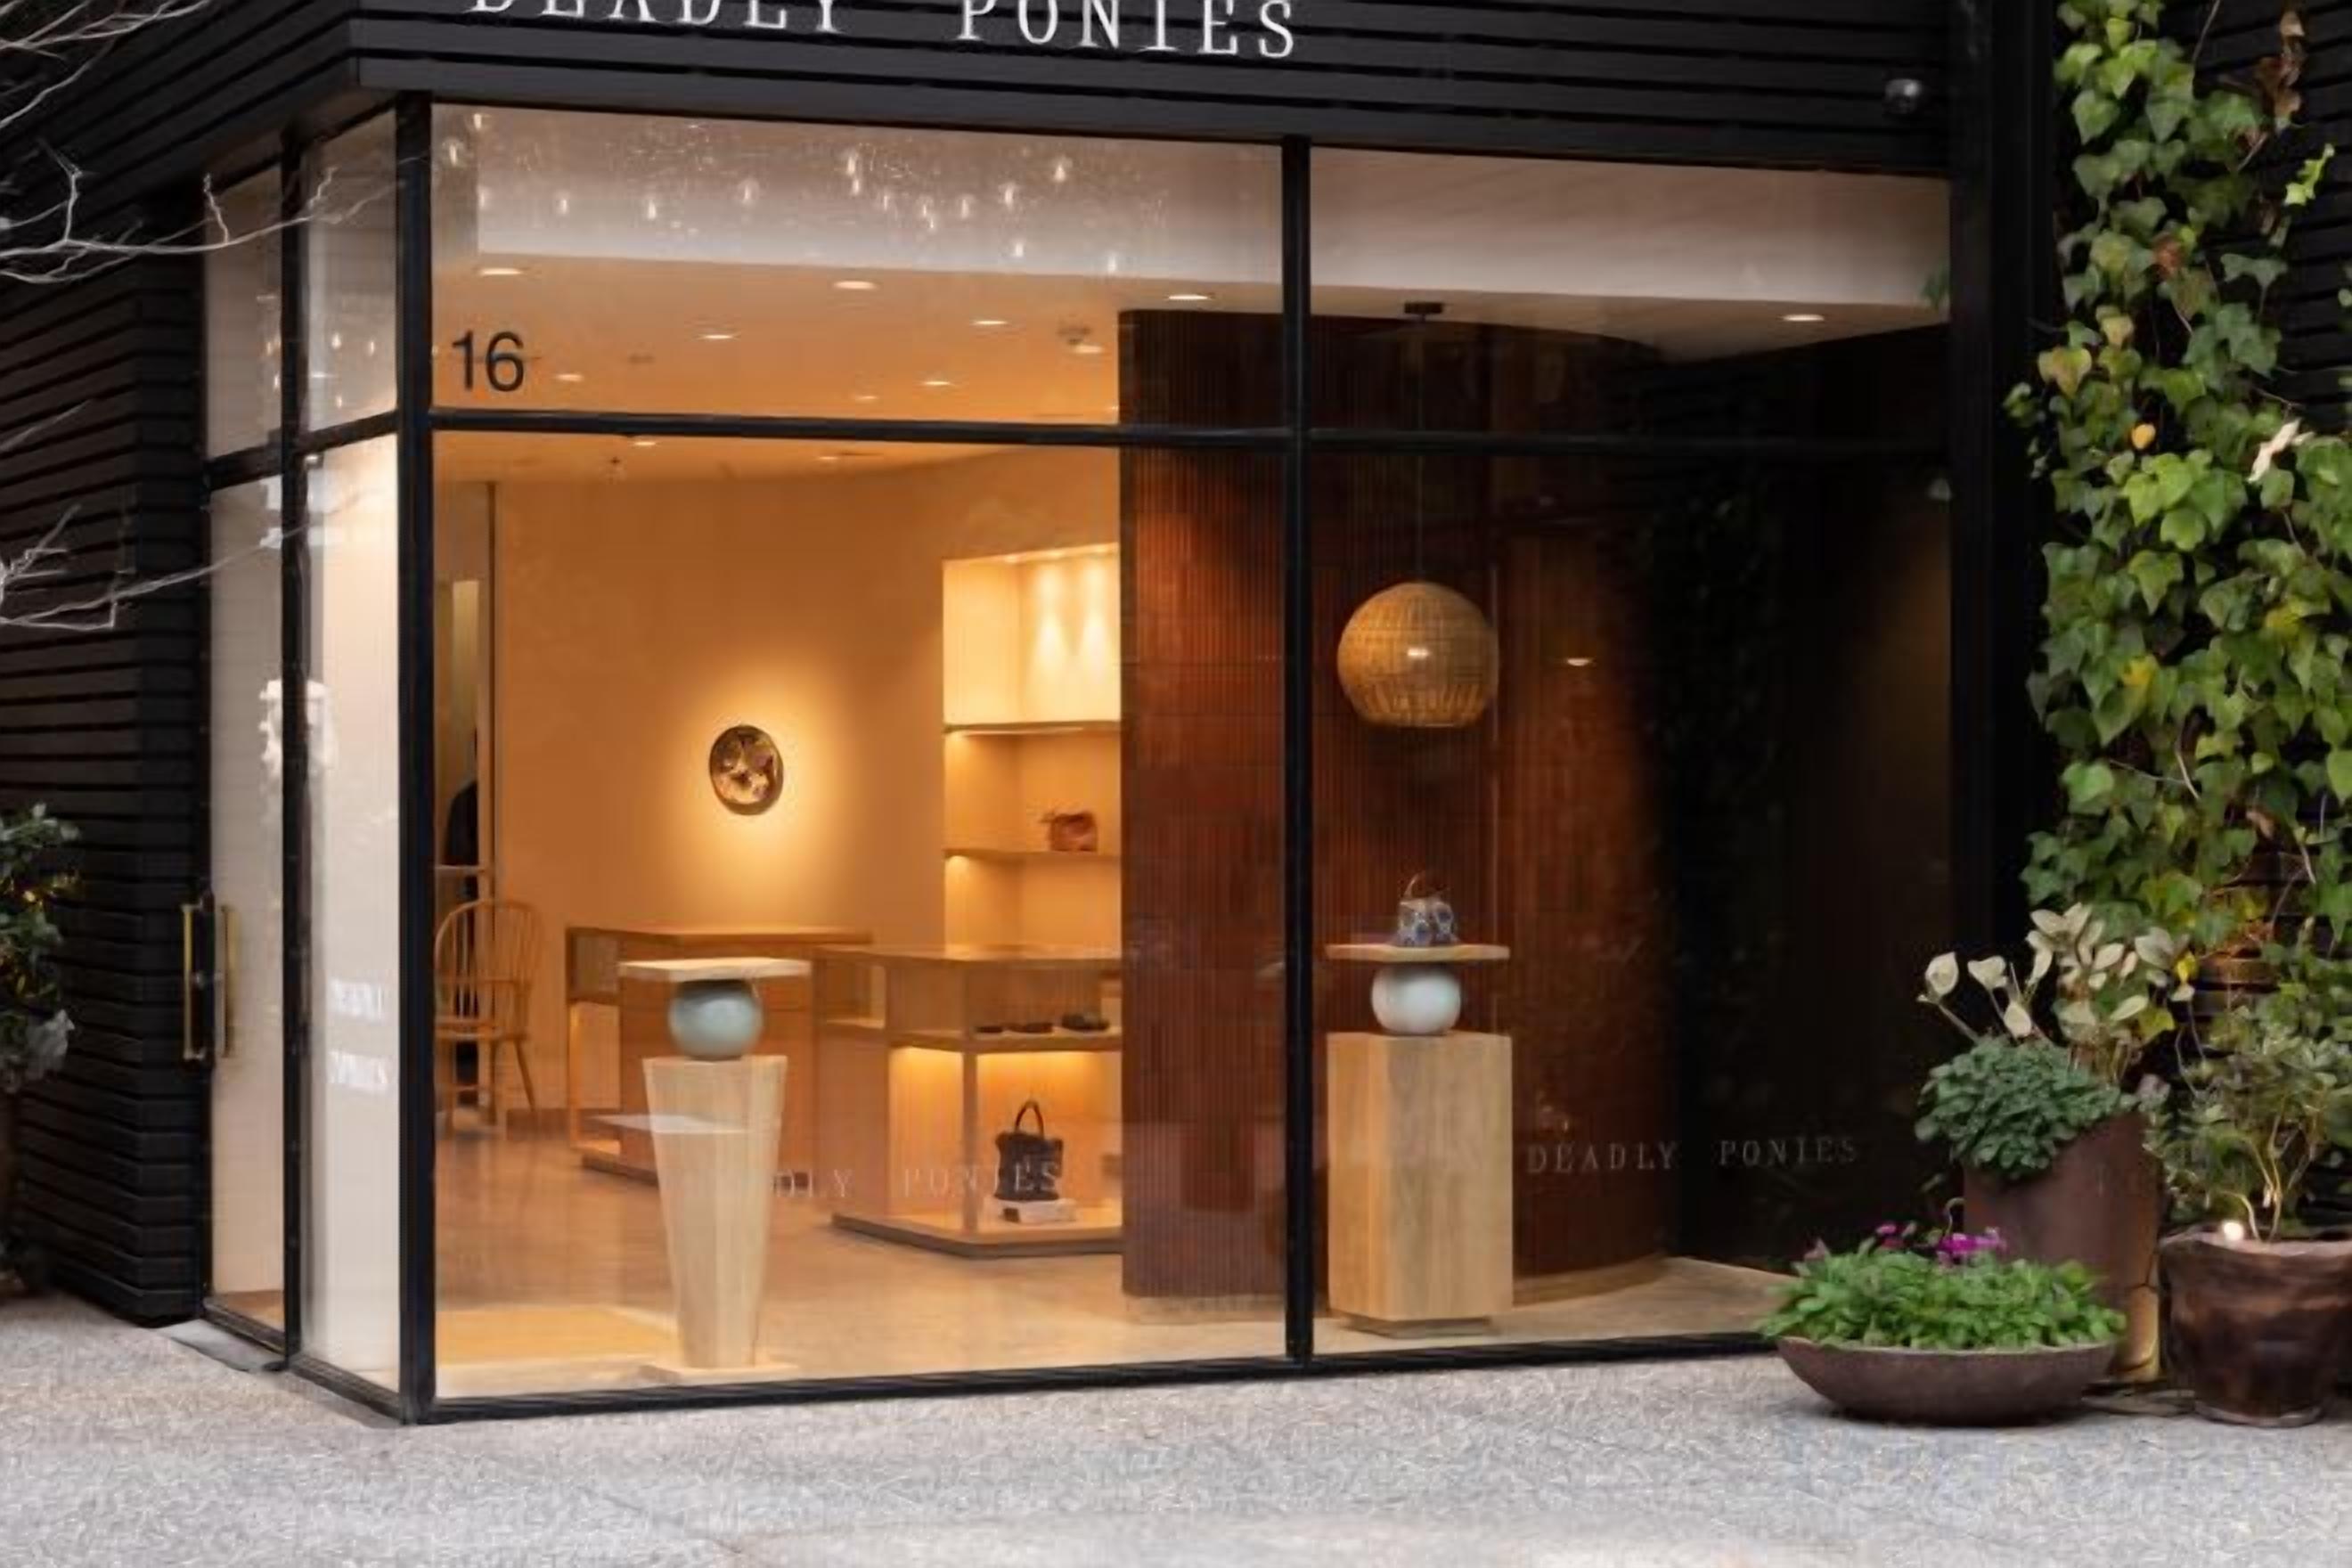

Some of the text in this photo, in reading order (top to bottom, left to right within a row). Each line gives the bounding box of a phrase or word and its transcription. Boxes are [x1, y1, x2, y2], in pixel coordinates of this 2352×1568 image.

[956, 0, 1294, 58] PONIES
[452, 329, 524, 392] 16
[1526, 1136, 1855, 1173] DEADLY PONIES
